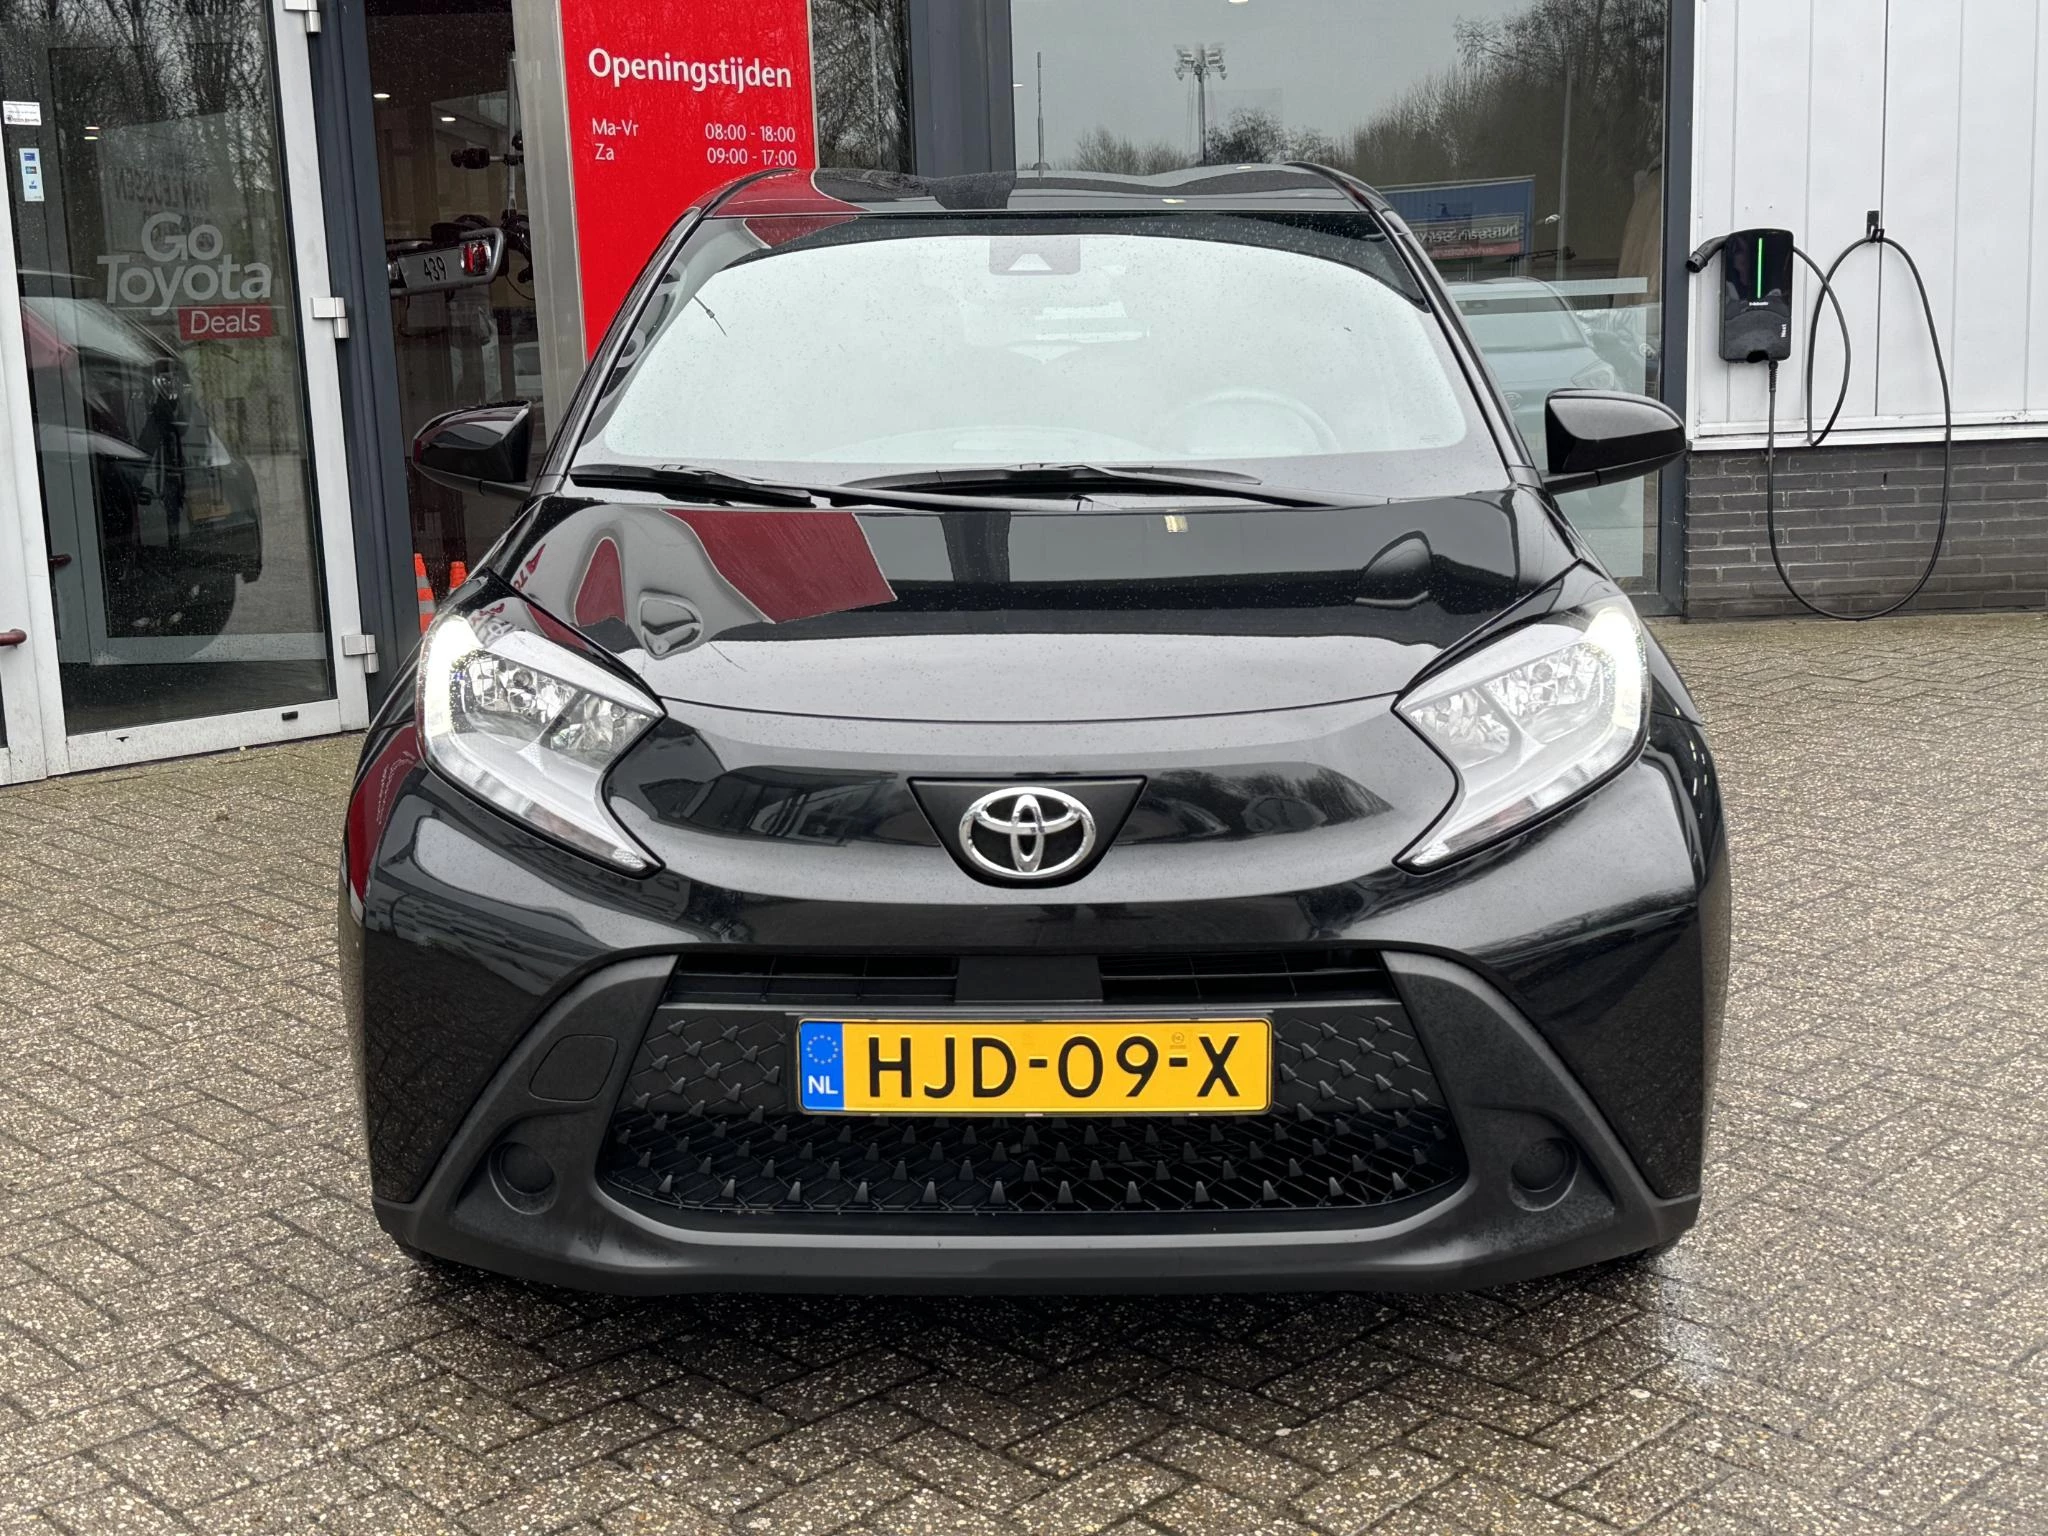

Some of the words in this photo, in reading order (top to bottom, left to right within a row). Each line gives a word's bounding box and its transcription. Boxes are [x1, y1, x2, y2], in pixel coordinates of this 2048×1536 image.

[588, 47, 792, 93] Openingstijden
[592, 118, 639, 137] Ma-Vr
[705, 123, 747, 142] 08:00
[760, 125, 796, 143] 18:00
[595, 143, 615, 161] Za
[707, 147, 748, 165] 09:00
[762, 150, 797, 166] 17:00
[141, 211, 224, 263] Go
[423, 256, 447, 282] 439
[97, 253, 272, 317] Toyota
[190, 307, 261, 335] Deals
[868, 1035, 1241, 1098] HJD-09-X
[808, 1076, 838, 1095] NL
